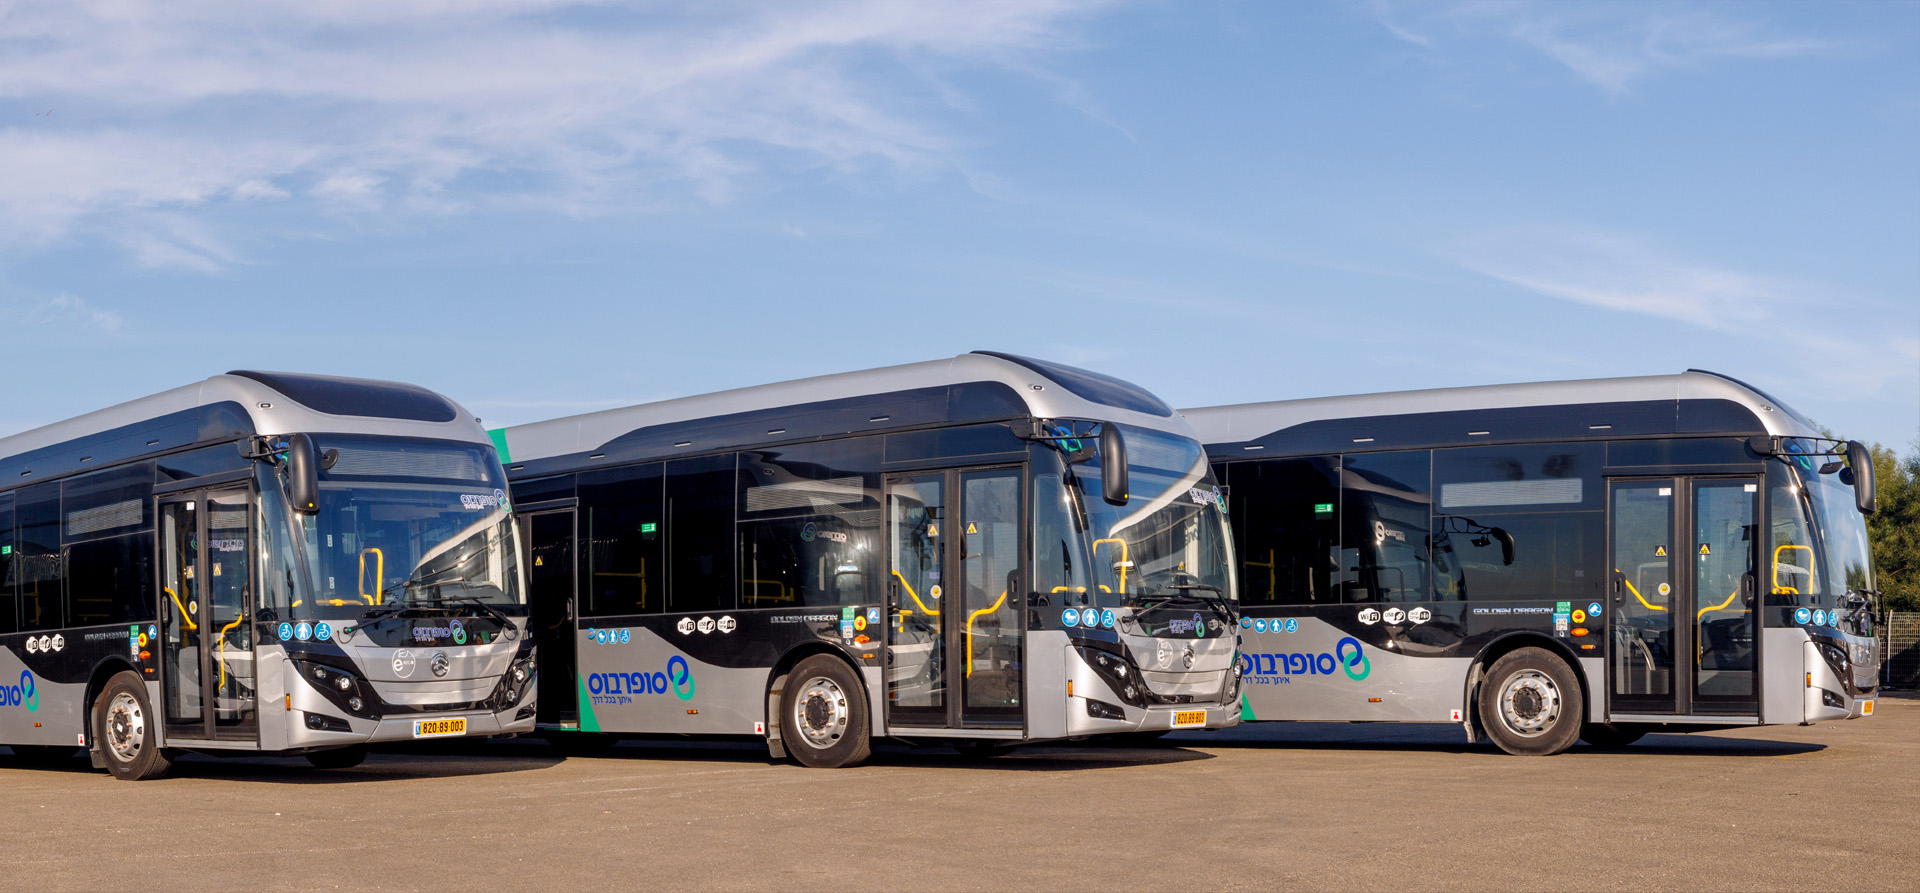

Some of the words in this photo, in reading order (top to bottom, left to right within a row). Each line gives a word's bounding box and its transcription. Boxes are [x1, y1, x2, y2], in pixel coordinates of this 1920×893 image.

[588, 671, 668, 695] סופרבוס
[1243, 676, 1252, 684] דר
[1254, 675, 1270, 684] בכל
[1271, 676, 1290, 686] איתך
[592, 696, 603, 706] דרך
[604, 695, 617, 704] בכל
[617, 696, 632, 706] איתך
